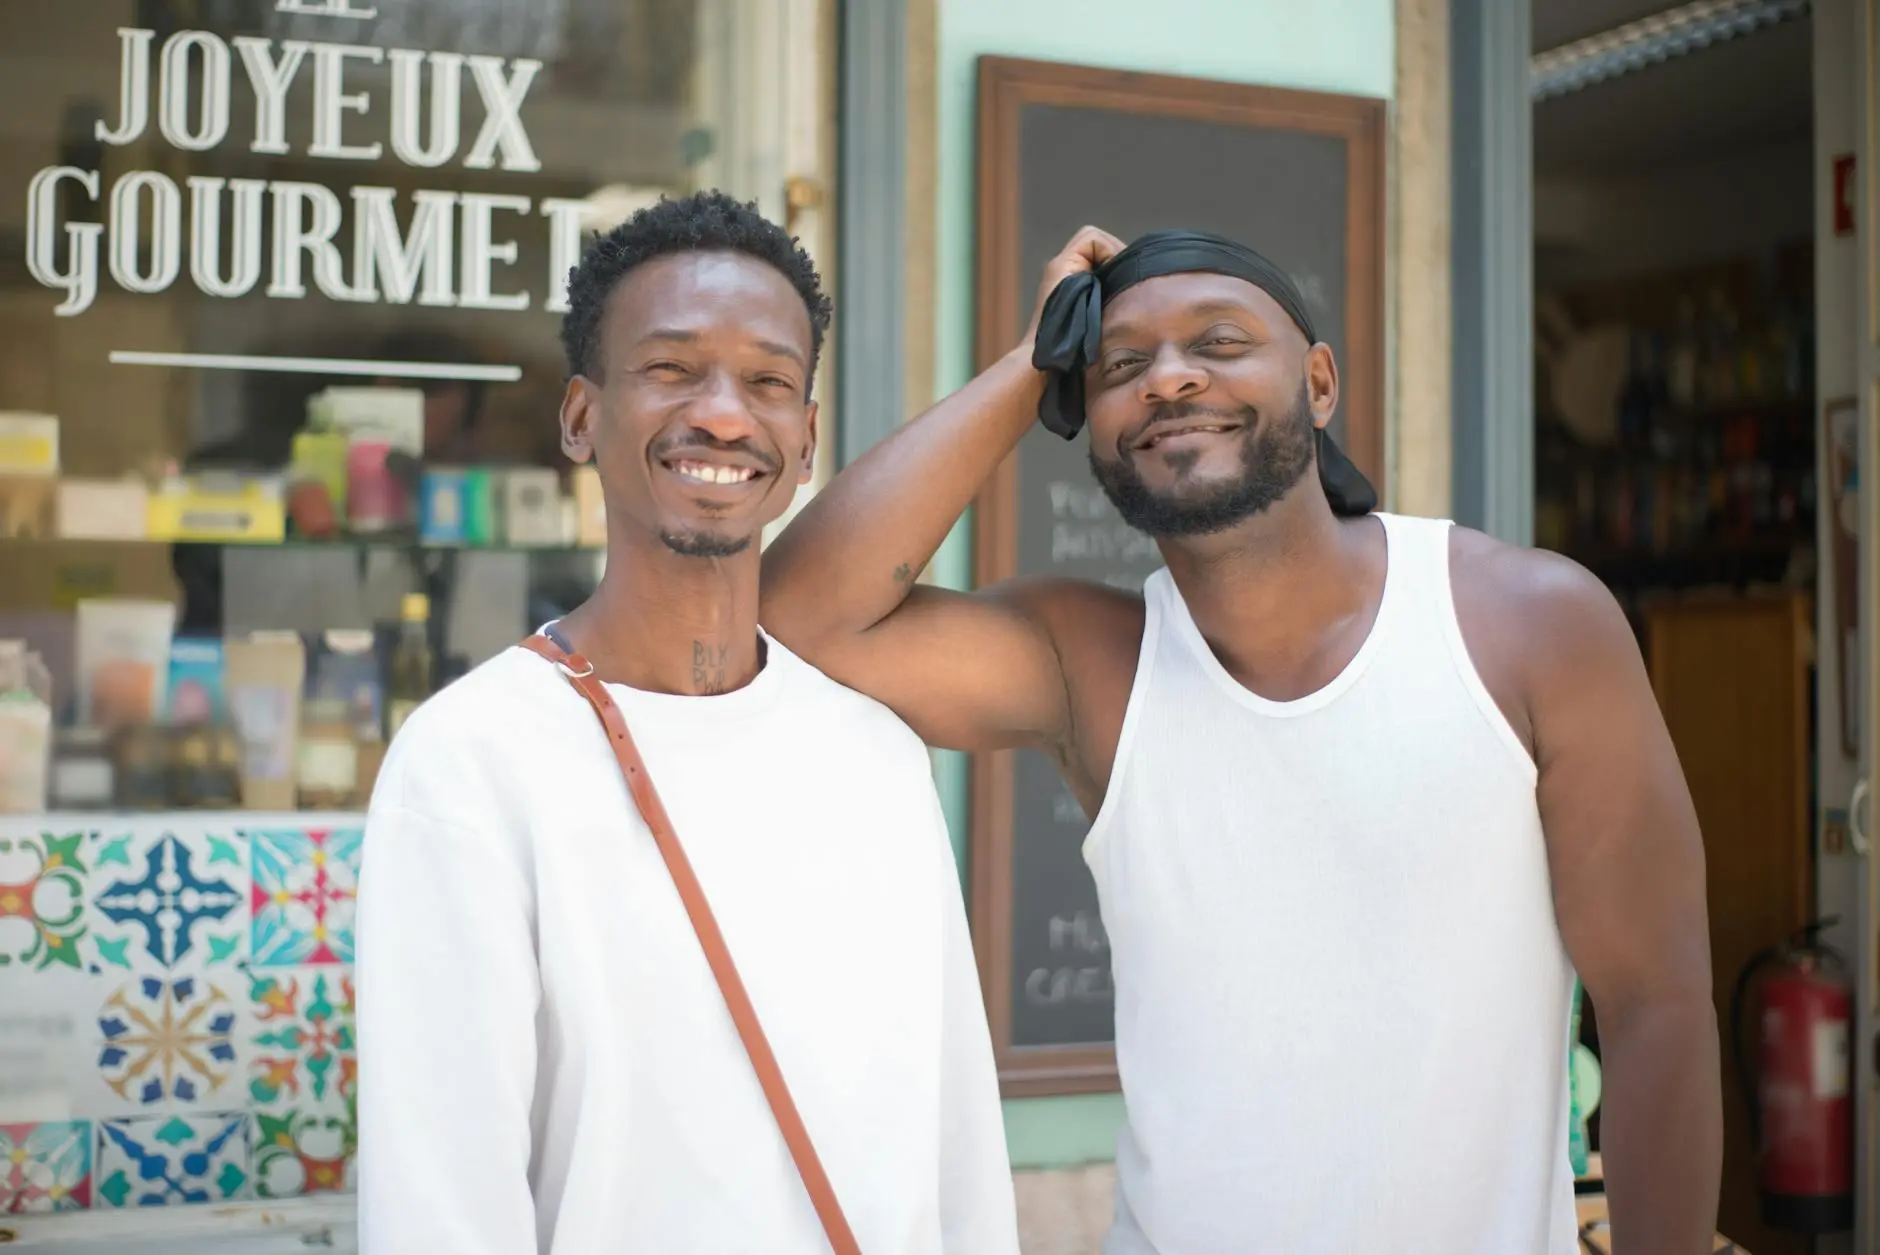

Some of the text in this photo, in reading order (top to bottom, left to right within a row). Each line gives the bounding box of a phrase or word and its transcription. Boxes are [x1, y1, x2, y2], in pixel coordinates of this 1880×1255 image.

[95, 27, 543, 172] JOYEUX
[26, 165, 598, 317] GOURMET
[692, 639, 729, 668] BLK
